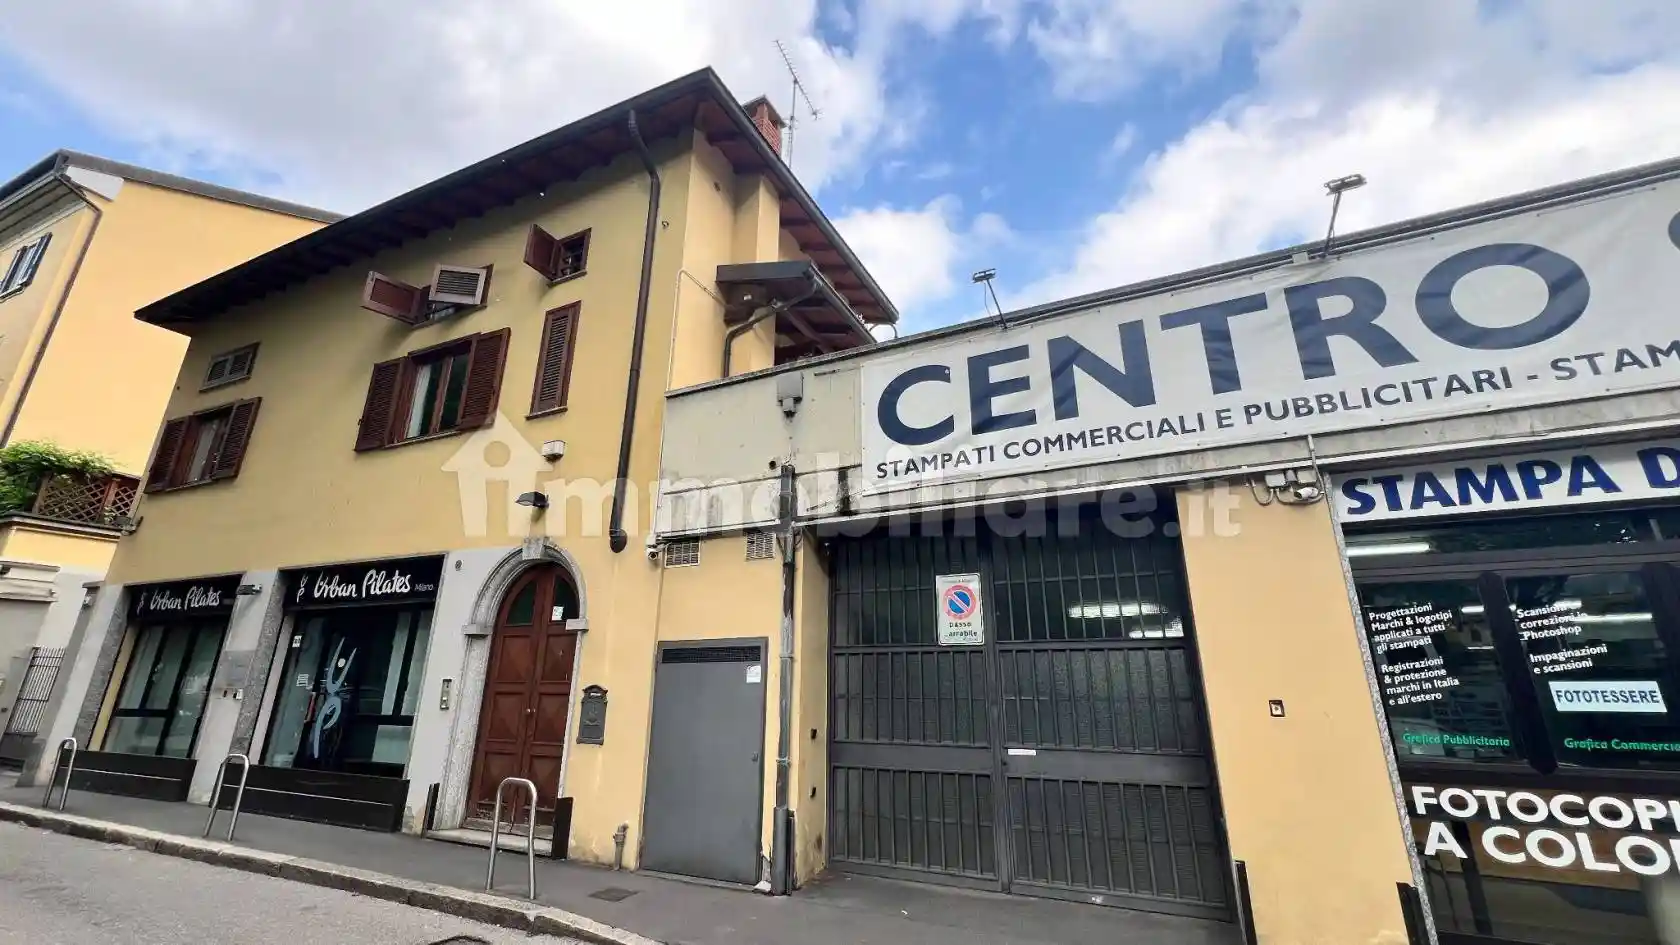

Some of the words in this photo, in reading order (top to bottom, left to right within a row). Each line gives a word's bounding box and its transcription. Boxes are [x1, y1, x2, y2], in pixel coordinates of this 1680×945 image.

[878, 243, 1590, 445] CENTRO
[877, 446, 995, 479] STAMPATI
[1003, 412, 1205, 460] COMMERCIALI
[1215, 408, 1234, 429] E
[1244, 366, 1512, 424] PUBBLICITARI
[1341, 455, 1623, 515] STAMPA
[313, 570, 358, 598] Urban
[361, 568, 411, 598] Pilates
[150, 587, 181, 610] Urban
[184, 585, 222, 611] Pilates
[1368, 602, 1433, 621] Progettazioni
[1371, 618, 1403, 632] Marchi
[1405, 615, 1414, 625] &
[1415, 610, 1453, 626] logotipi
[1373, 626, 1414, 644] applicati
[1415, 627, 1422, 635] a
[1423, 622, 1445, 634] tutti
[1523, 626, 1582, 640] Photoshop
[1376, 642, 1388, 655] gli
[1390, 635, 1432, 651] stampati
[1529, 643, 1608, 664] Impaginazioni
[1381, 656, 1444, 675] Registrazioni
[1533, 666, 1541, 674] e
[1543, 658, 1593, 674] scansioni
[1384, 675, 1392, 684] &
[1394, 668, 1447, 685] protezione
[1386, 681, 1421, 695] marchi
[1422, 679, 1432, 690] in
[1433, 676, 1460, 688] Italia
[1389, 698, 1396, 706] e
[1555, 689, 1660, 703] FOTOTESSERE
[1403, 732, 1441, 747] Grafica
[1443, 734, 1511, 747] Pubblicitaria
[1564, 737, 1608, 751] Grafica
[1424, 821, 1468, 859] A
